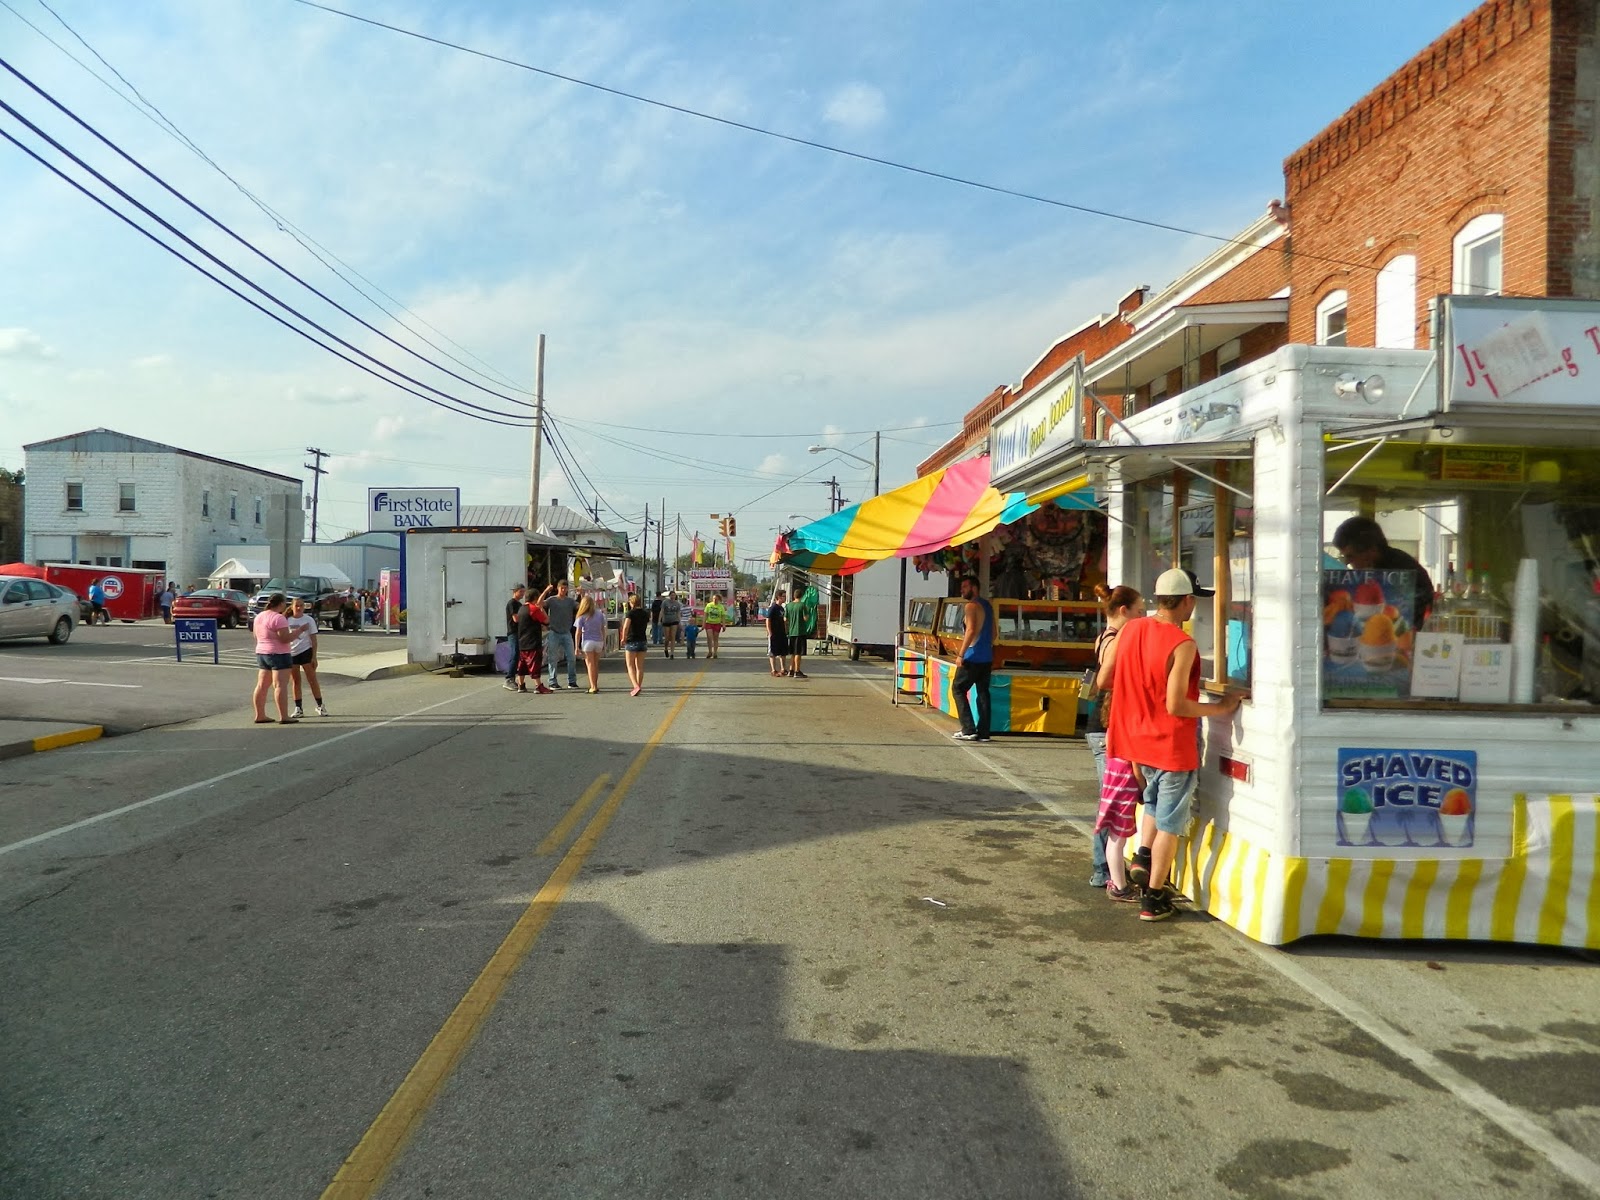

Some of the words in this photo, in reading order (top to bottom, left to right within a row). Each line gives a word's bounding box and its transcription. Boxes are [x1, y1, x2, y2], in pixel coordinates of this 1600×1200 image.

[375, 493, 412, 511] First
[415, 497, 452, 511] State
[394, 515, 433, 526] BANK
[1383, 571, 1409, 585] ICE
[179, 632, 213, 640] ENTER
[1343, 753, 1473, 788] SHAVED
[1373, 782, 1441, 809] ICE
